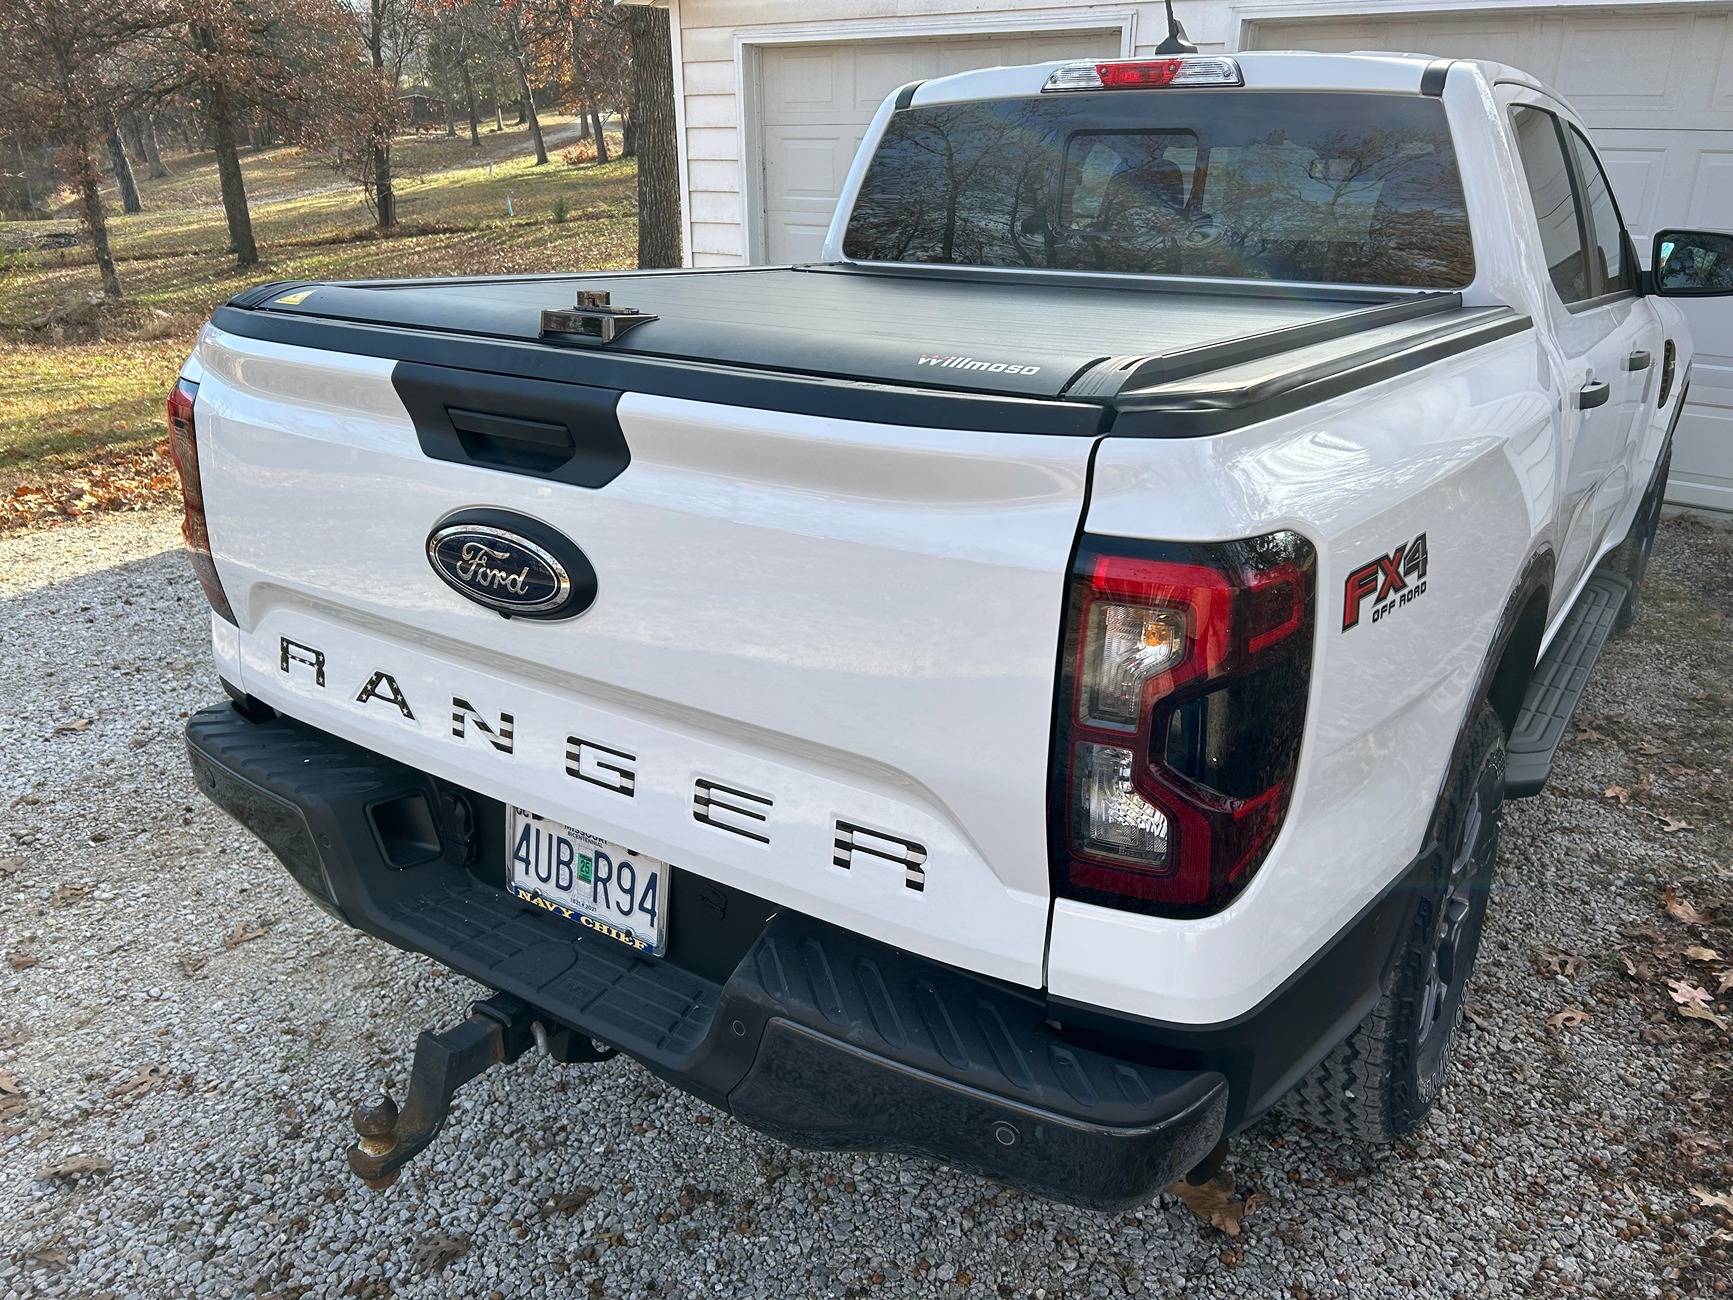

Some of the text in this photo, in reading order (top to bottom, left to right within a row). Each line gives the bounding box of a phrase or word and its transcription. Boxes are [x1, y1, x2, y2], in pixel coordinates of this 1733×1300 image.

[456, 541, 530, 596] Ford
[1341, 530, 1429, 635] FX4
[1372, 581, 1428, 624] OFF ROAD
[280, 635, 928, 893] RANGER
[567, 830, 604, 849] BICENTENNIAL
[580, 859, 590, 875] 25
[513, 822, 659, 928] 4UB R94
[517, 888, 648, 951] NAVY CHIEF
